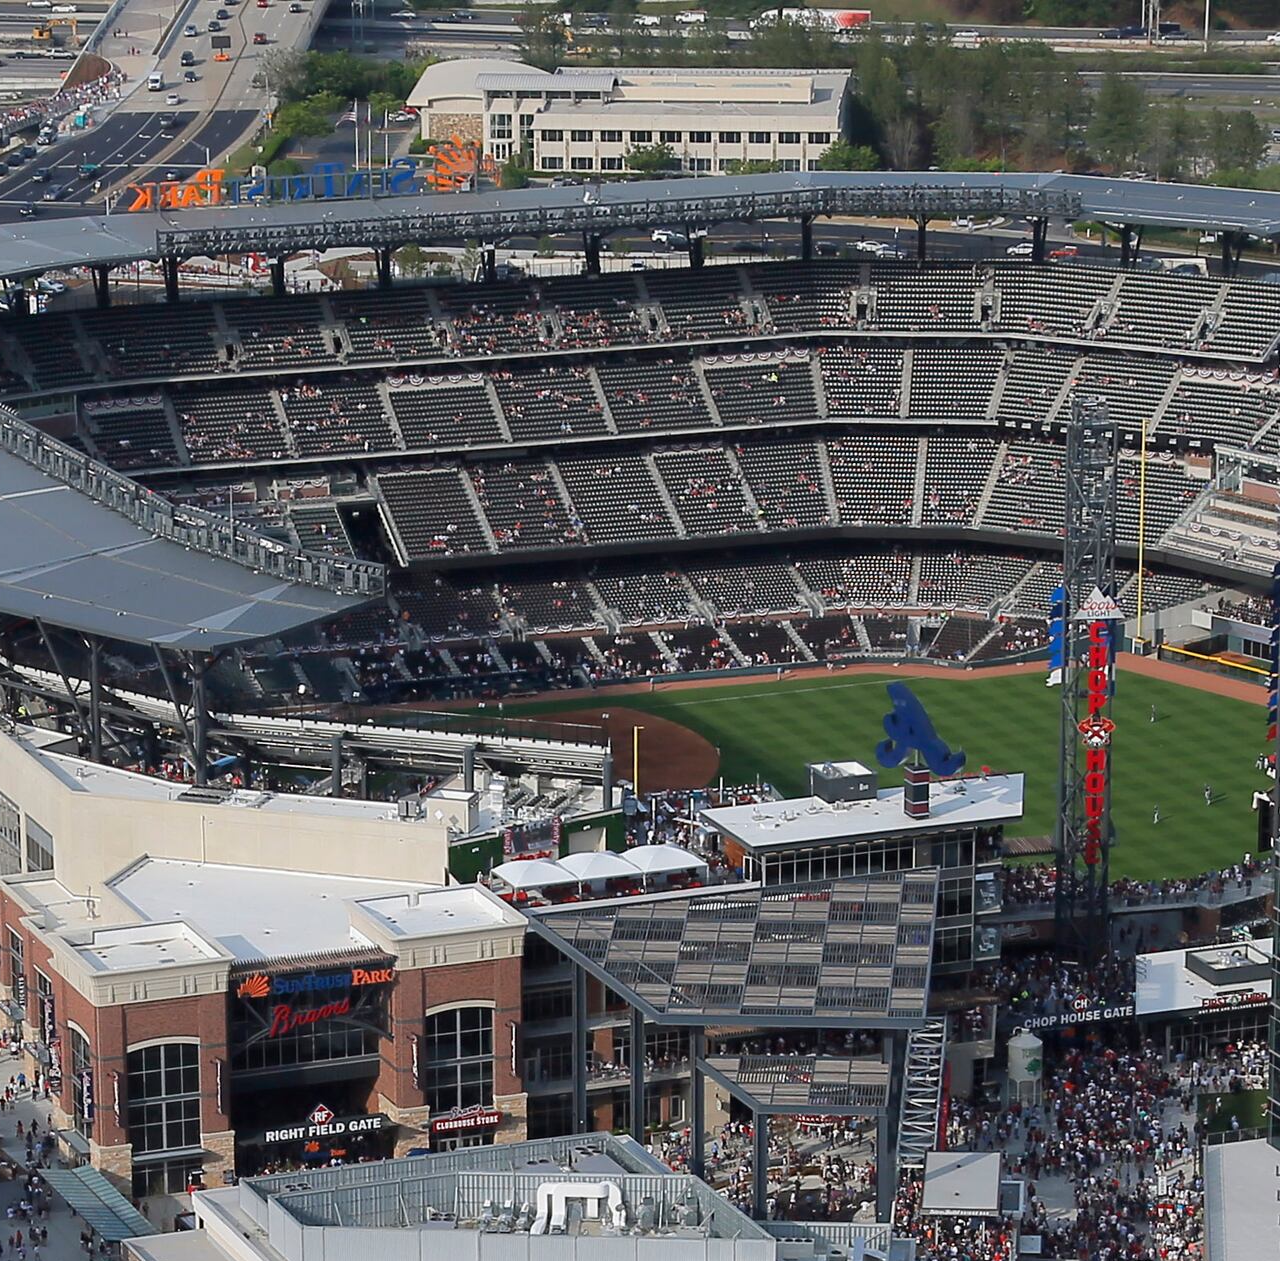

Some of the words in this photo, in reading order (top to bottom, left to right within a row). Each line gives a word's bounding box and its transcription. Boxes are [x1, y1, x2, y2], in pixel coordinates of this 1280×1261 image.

[1081, 599, 1118, 612] Coors
[1087, 610, 1111, 618] LIGHT
[1088, 620, 1109, 715] CHOP
[1085, 748, 1107, 865] HOUSE
[351, 967, 394, 987] PARK
[1073, 998, 1088, 1010] CH
[269, 998, 350, 1038] Braves
[1024, 1015, 1058, 1029] CHOP
[1060, 1010, 1101, 1025] HOUSE
[1104, 1005, 1133, 1020] GATE
[314, 1110, 329, 1123] RF
[476, 1115, 499, 1126] STORE
[265, 1127, 306, 1143] RIGHT
[308, 1122, 346, 1138] FIELD
[349, 1117, 382, 1132] GATE
